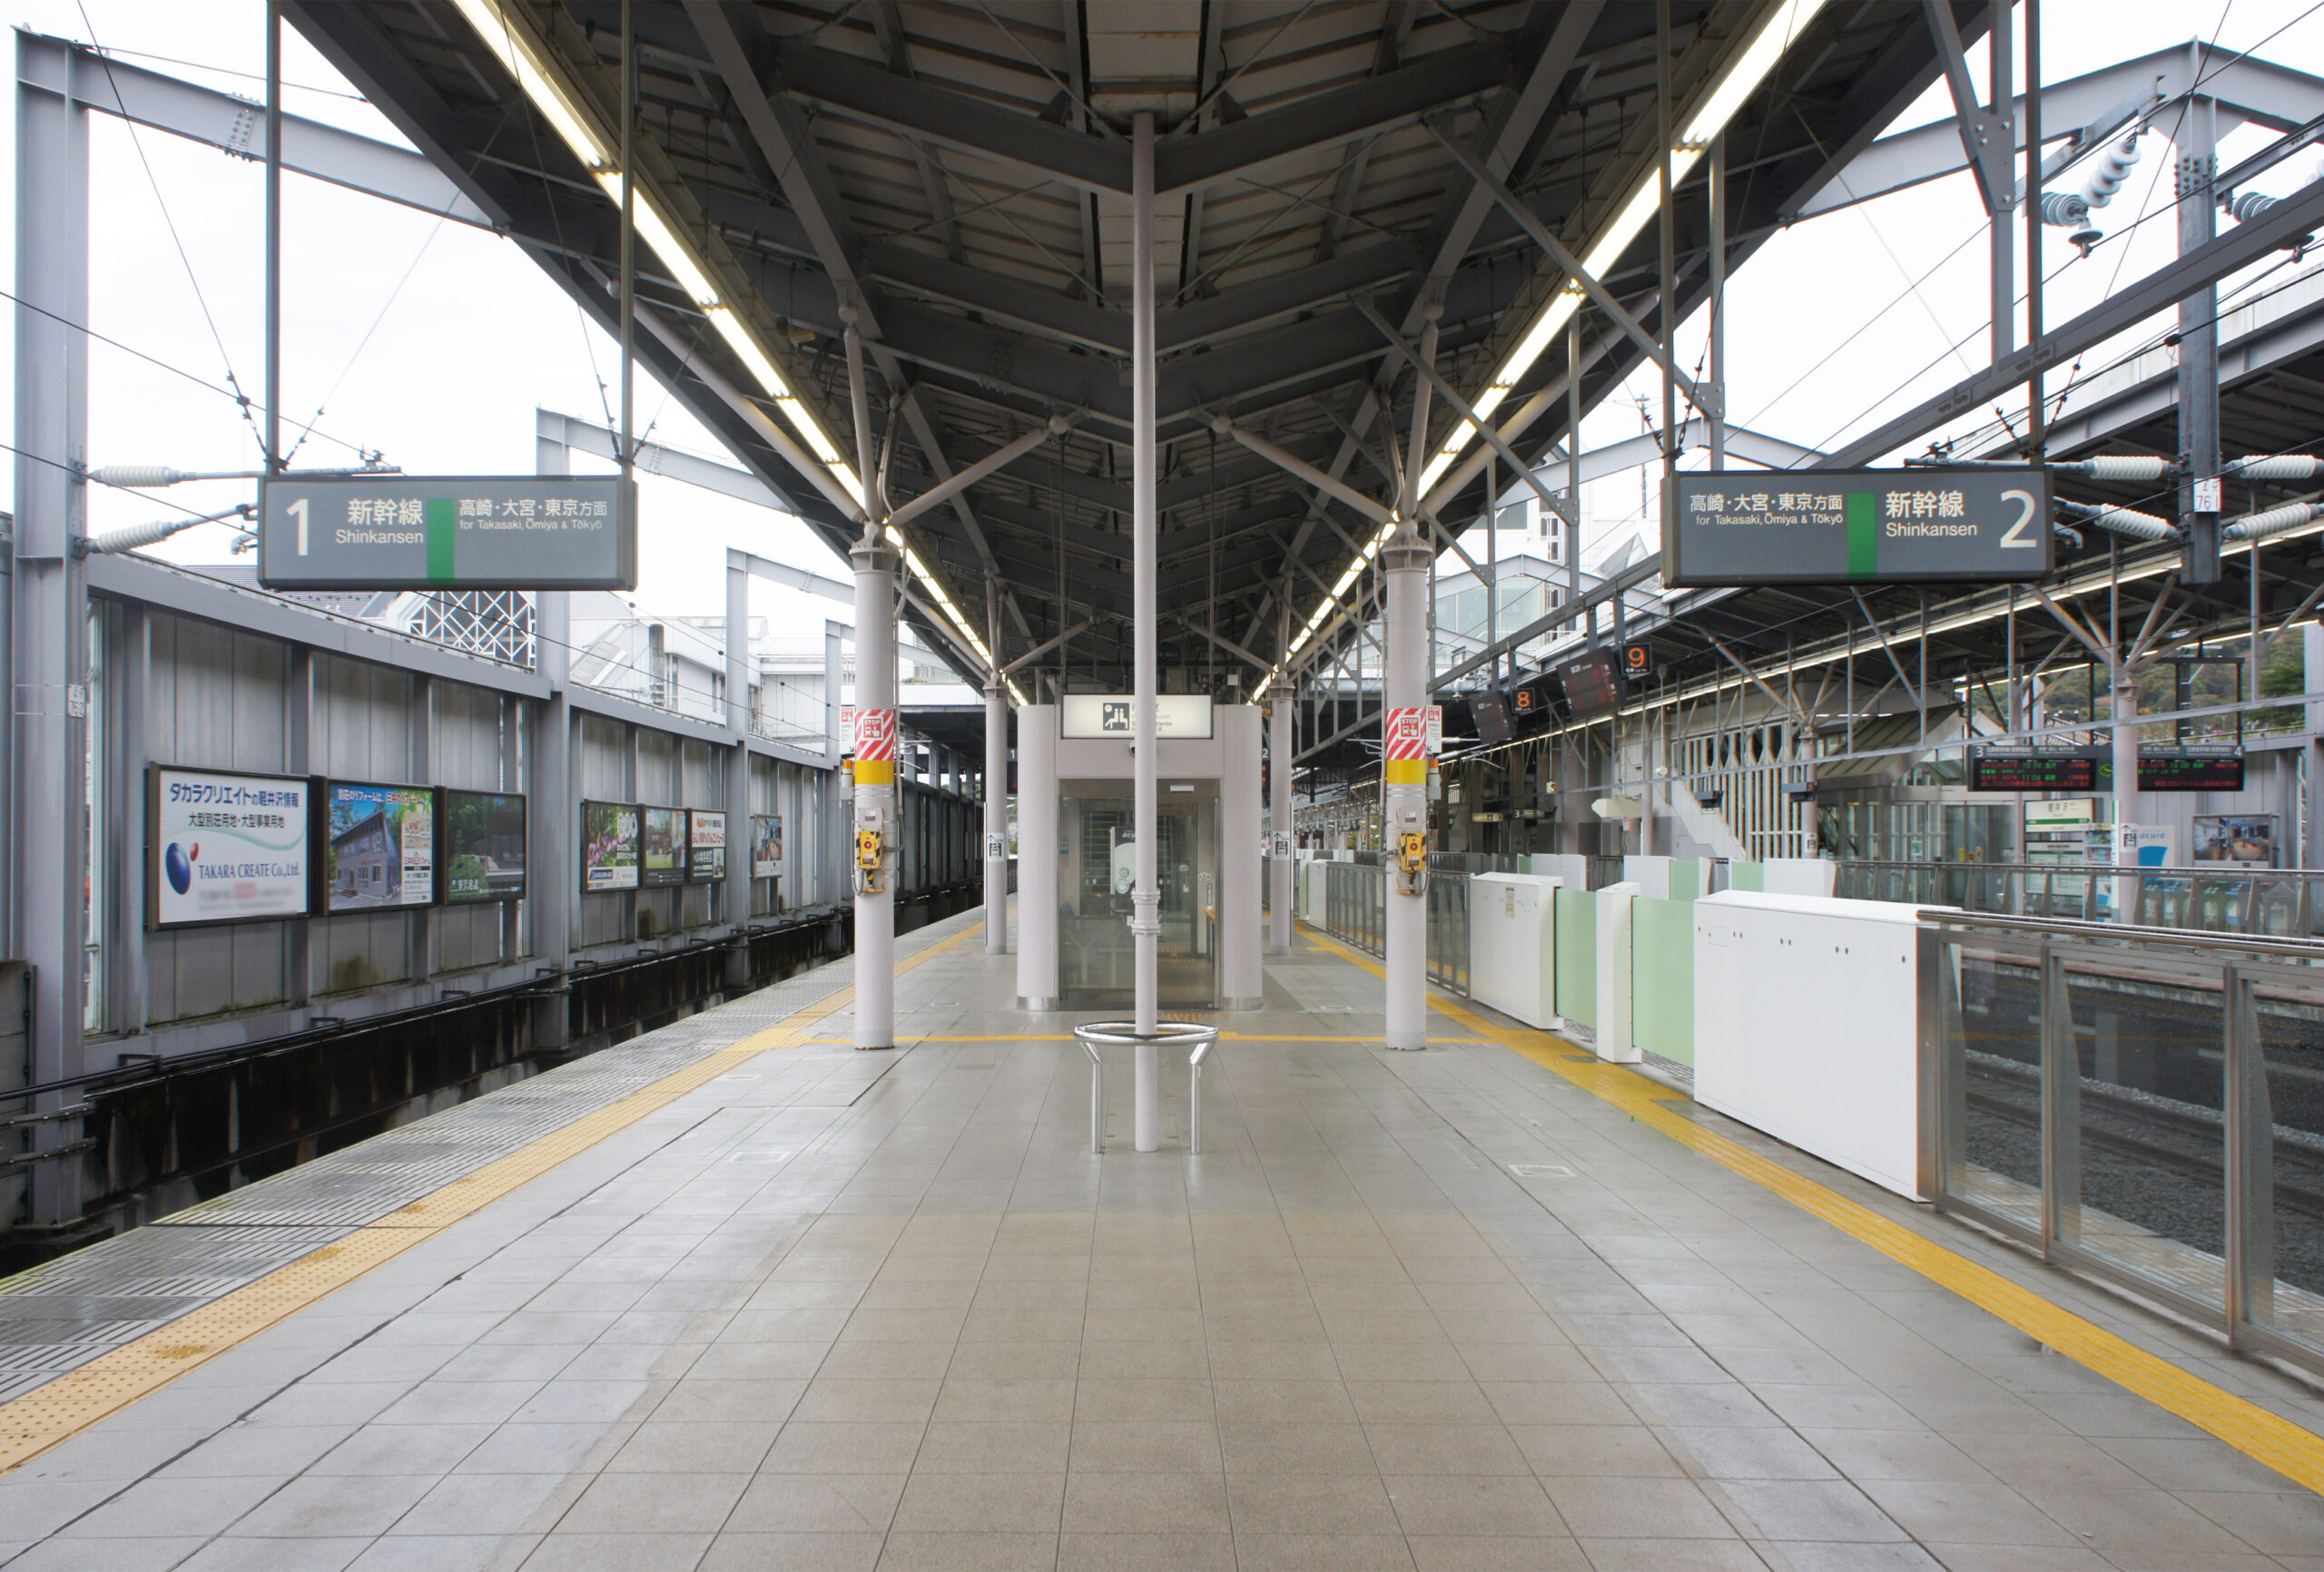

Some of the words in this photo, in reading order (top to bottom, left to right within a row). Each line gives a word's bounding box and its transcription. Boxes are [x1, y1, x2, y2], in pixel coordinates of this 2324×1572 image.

[459, 498, 607, 516] 高崎・大宮・東京方面
[1689, 493, 1844, 513] 高崎・大宮・東京方面
[1885, 490, 1965, 518] 新幹線
[348, 498, 424, 526] 新幹線
[1696, 515, 1710, 526] for
[1714, 514, 1763, 526] Takasaki,
[1764, 513, 1798, 526] Ōmiya
[1801, 516, 1808, 524] &
[1811, 513, 1844, 526] Tōkyō
[1999, 489, 2038, 549] 2
[285, 498, 310, 556] 1
[459, 519, 474, 530] for
[478, 519, 525, 531] Takasaki,
[526, 517, 558, 531] Ōmiya
[562, 521, 568, 529] &
[571, 518, 603, 531] Tōkyō
[1886, 523, 1978, 538] Shinkansen
[335, 530, 424, 545] Shinkansen
[1628, 647, 1646, 668] 9
[1517, 691, 1530, 708] 8
[1262, 749, 1269, 759] 2
[1975, 747, 1984, 757] 3
[2234, 746, 2244, 757] 4
[170, 782, 300, 808] タカラクリエイトの軽井沢情報
[199, 864, 236, 879] TAKARA
[238, 863, 270, 878] CREATE
